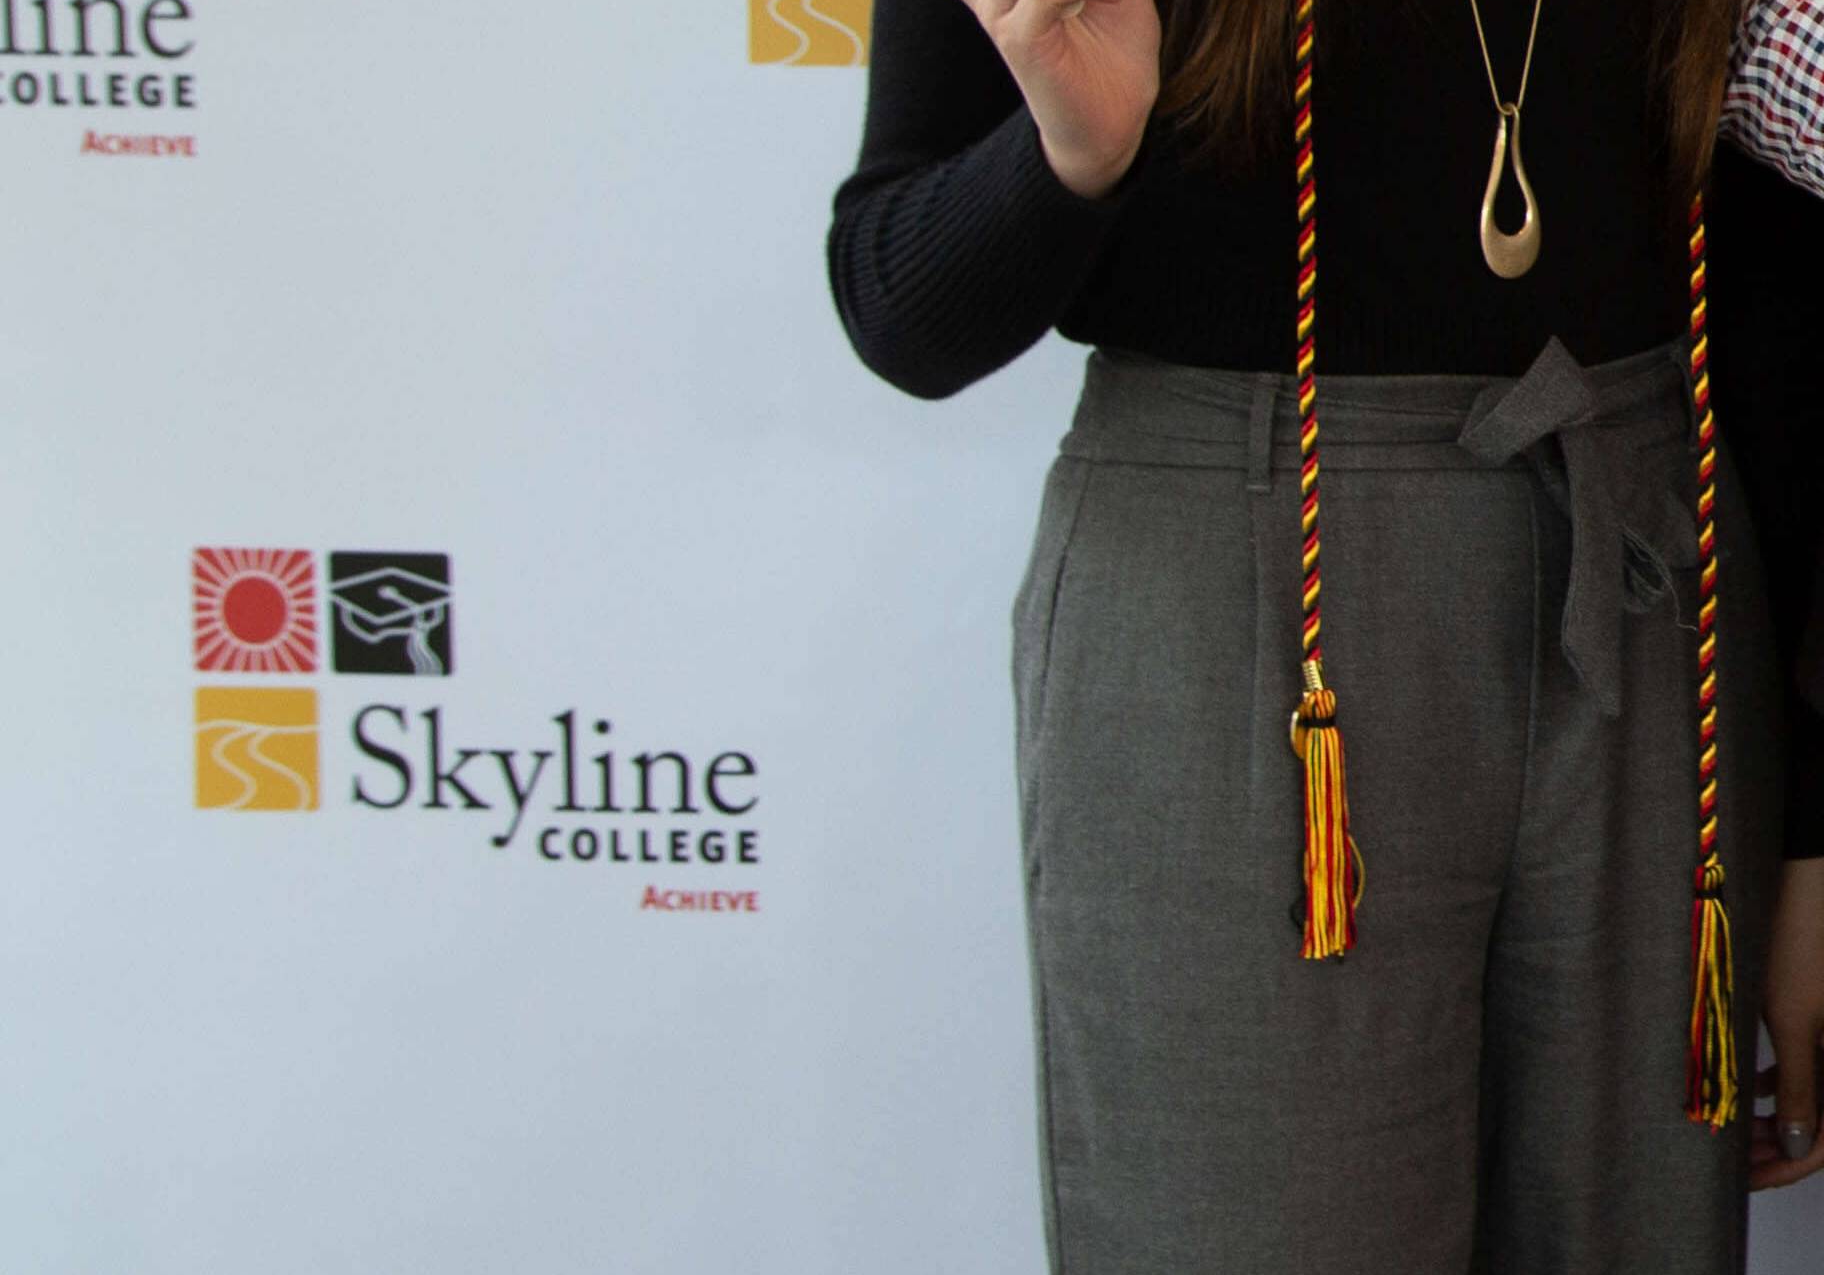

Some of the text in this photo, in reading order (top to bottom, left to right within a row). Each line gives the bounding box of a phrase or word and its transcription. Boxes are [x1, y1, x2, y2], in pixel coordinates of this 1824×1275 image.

[0, 71, 196, 109] OLLEGE
[351, 703, 760, 849] Skyline
[539, 826, 761, 864] COLLEGE
